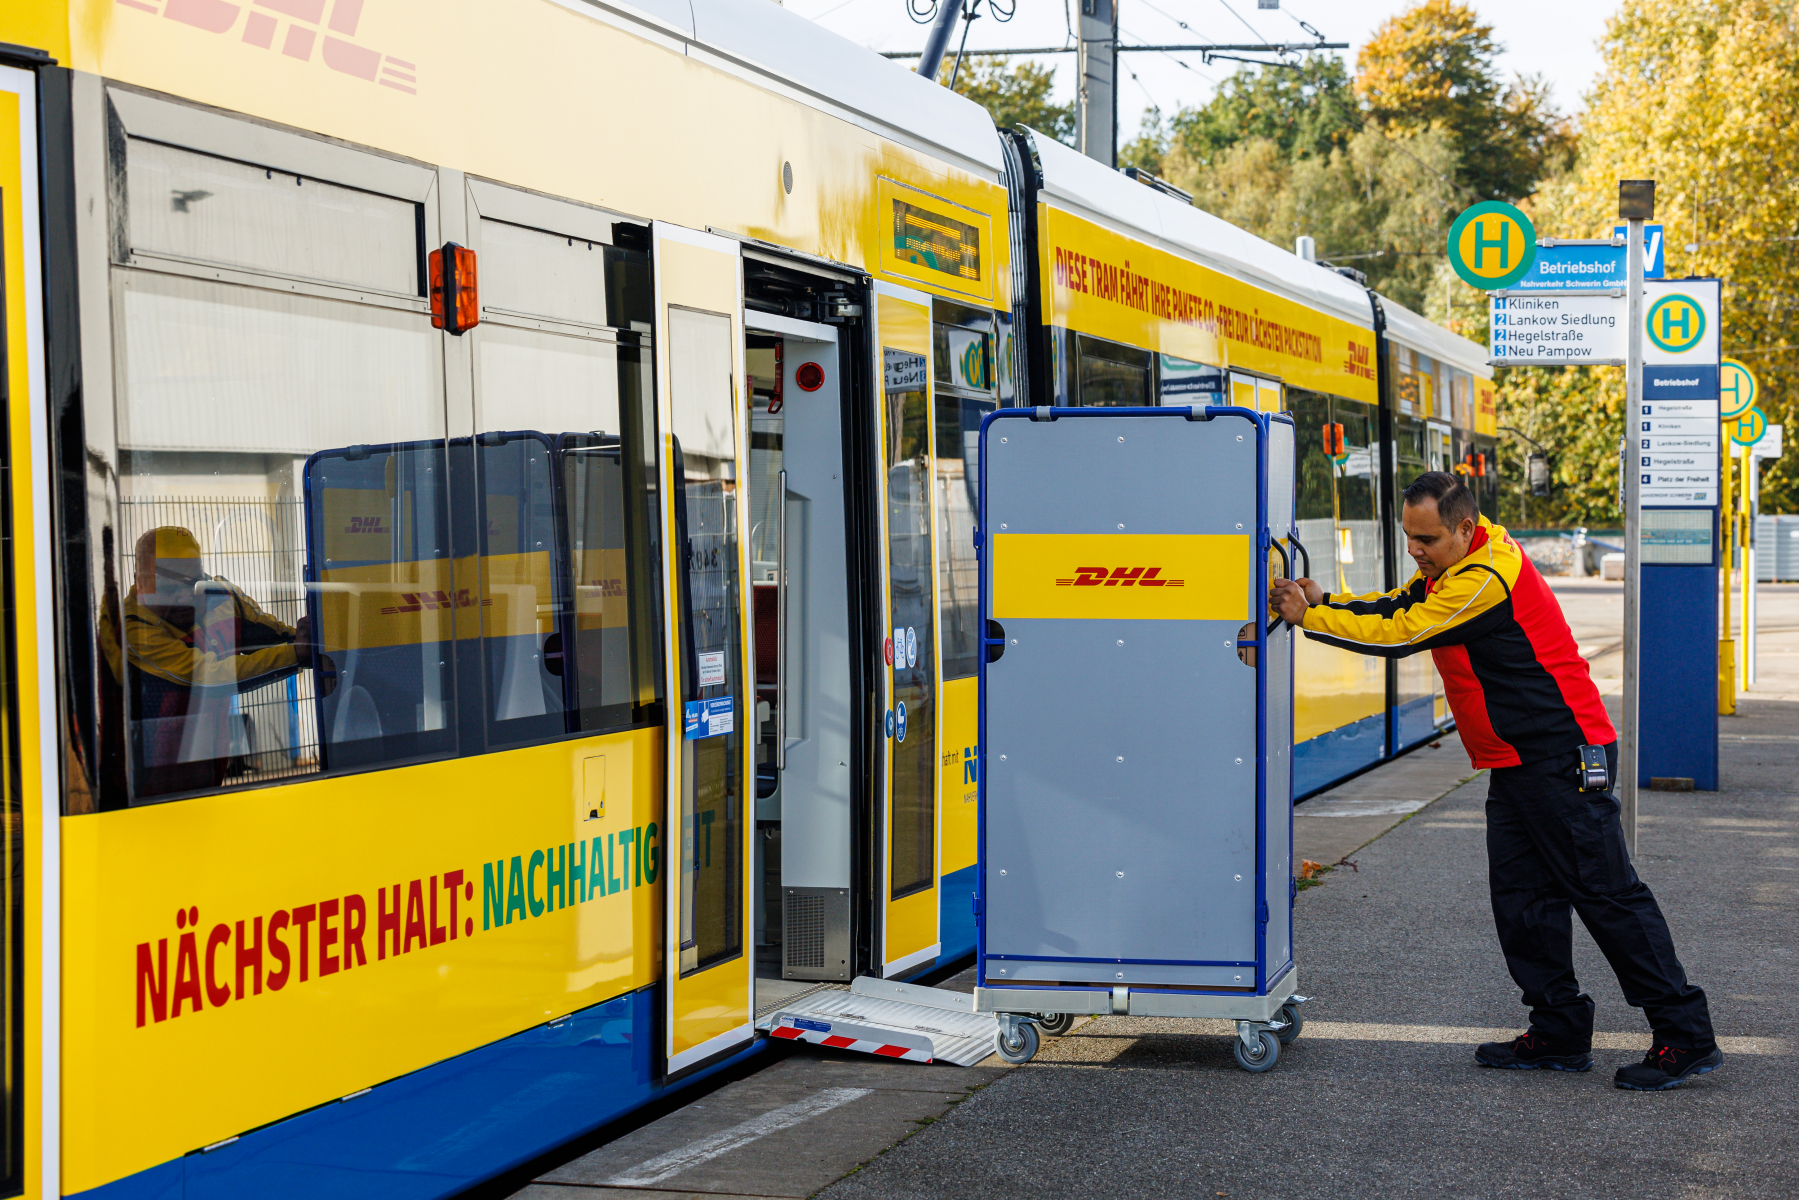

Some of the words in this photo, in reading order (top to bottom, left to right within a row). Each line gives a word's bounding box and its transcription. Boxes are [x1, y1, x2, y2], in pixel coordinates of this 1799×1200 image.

[1474, 222, 1509, 269] H
[1539, 260, 1616, 275] Betriebshof
[1520, 280, 1564, 288] Nahverkehr
[1565, 280, 1601, 288] Schwerin
[1602, 279, 1627, 288] GmbH
[1056, 246, 1088, 294] DIESE
[1089, 257, 1119, 303] TRAM
[1120, 260, 1149, 313] FÄHRT
[1151, 280, 1172, 320] IHRE
[1172, 288, 1202, 329] PAKETE
[1235, 310, 1250, 344] ZUR
[1250, 308, 1284, 354] NÄCHSTEN
[1284, 326, 1322, 363] PACKSTATION
[1497, 298, 1504, 309] 1
[1509, 299, 1559, 309] Kliniken
[1497, 314, 1505, 325] 2
[1509, 314, 1557, 326] Lankow
[1561, 313, 1615, 327] Siedlung
[1662, 307, 1690, 339] H
[1497, 330, 1505, 341] 2
[1509, 330, 1584, 344] Hegelstraße
[1497, 345, 1504, 356] 3
[1509, 346, 1533, 356] Neu
[1538, 345, 1592, 358] Pampow
[1653, 378, 1700, 387] Betriebshof
[1643, 406, 1649, 414] 1
[1643, 422, 1648, 430] 1
[1738, 415, 1754, 437] H
[1642, 440, 1649, 448] 2
[1642, 475, 1648, 483] 4
[1073, 567, 1168, 587] DHL
[136, 894, 368, 1029] NÄCHSTER
[377, 868, 474, 962] HALT:
